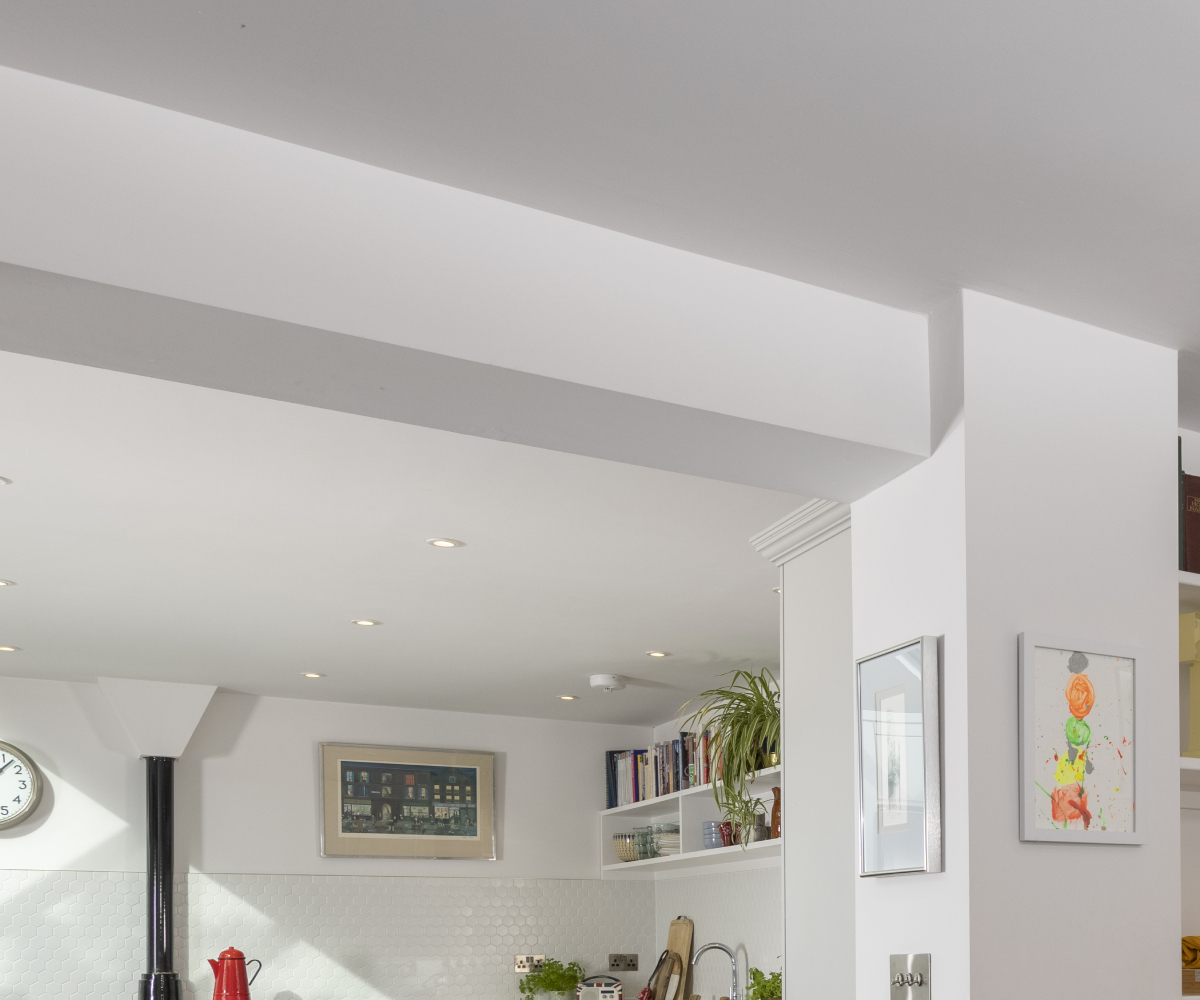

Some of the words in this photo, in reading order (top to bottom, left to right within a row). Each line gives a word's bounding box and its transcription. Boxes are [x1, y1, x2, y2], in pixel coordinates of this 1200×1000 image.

[2, 754, 5, 763] 1
[14, 765, 22, 774] 2
[19, 780, 27, 789] 3
[12, 795, 21, 804] 4
[1, 806, 8, 815] 5
